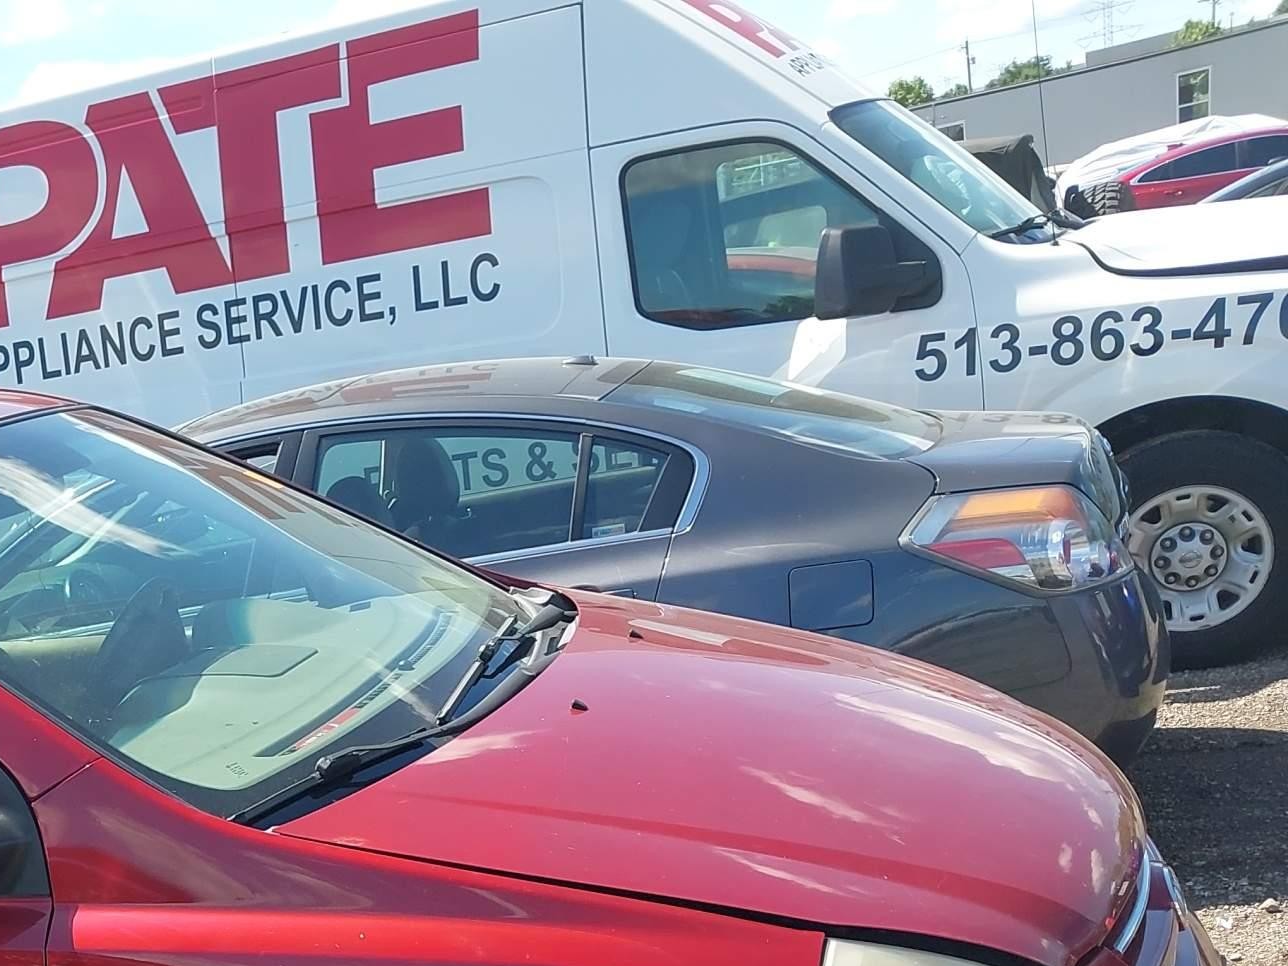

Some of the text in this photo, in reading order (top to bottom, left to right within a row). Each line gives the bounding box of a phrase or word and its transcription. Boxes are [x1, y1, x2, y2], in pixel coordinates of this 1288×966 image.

[196, 272, 397, 350] SERVICE,
[412, 252, 501, 313] LLC
[914, 292, 1288, 382] 513-863-47
[526, 441, 557, 482] &
